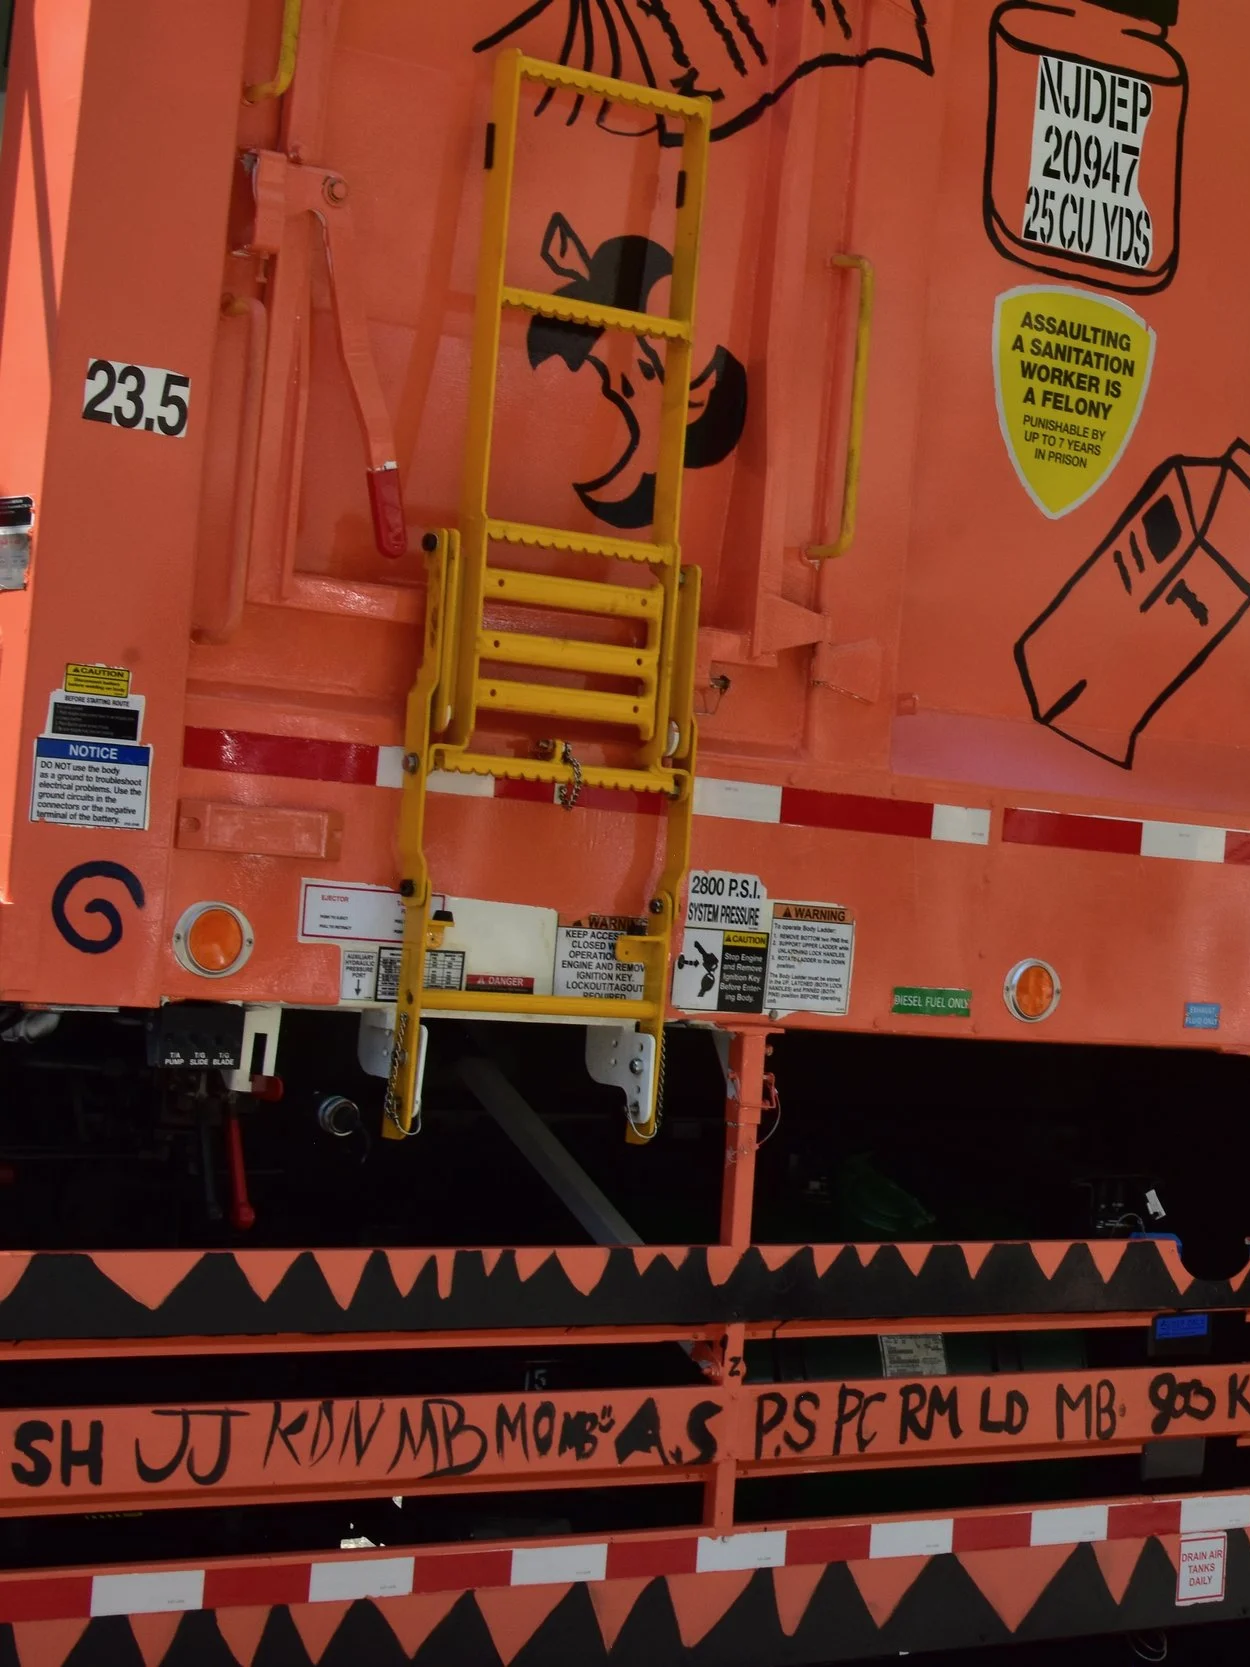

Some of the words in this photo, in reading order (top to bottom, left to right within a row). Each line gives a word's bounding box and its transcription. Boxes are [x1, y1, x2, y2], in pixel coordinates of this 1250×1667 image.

[1039, 57, 1151, 134] NJDEP
[1042, 125, 1139, 196] 20947
[1024, 186, 1055, 243] 25
[1059, 193, 1095, 253] CU
[1102, 202, 1150, 267] YDS
[1021, 312, 1131, 352] ASSAULTING
[1012, 335, 1024, 353] A
[1030, 338, 1135, 377] SANITATION
[1021, 360, 1100, 394] WORKER
[1105, 379, 1121, 398] IS
[82, 360, 190, 436] 23.5
[1023, 387, 1035, 405] A
[1041, 390, 1112, 420] FELONY
[1023, 415, 1089, 438] PUNISHABLE
[1092, 430, 1106, 441] BY
[1024, 431, 1039, 442] UP
[1042, 434, 1056, 446] TO
[1059, 438, 1064, 448] 7
[1068, 439, 1101, 455] YEARS
[1035, 448, 1046, 460] IN
[1048, 451, 1087, 468] PRISON
[80, 667, 124, 677] CAUTION
[69, 744, 118, 759] NOTICE
[55, 762, 71, 770] NOT
[101, 766, 120, 775] body
[57, 773, 84, 782] ground
[95, 775, 141, 786] troubleshoot
[39, 781, 73, 790] electrical
[75, 784, 111, 794] problems.
[114, 786, 128, 795] Use
[130, 788, 141, 796] the
[38, 791, 65, 800] ground
[67, 794, 94, 802] circuits
[37, 801, 79, 811] connectors
[105, 806, 136, 815] negative
[36, 811, 67, 819] terminal
[69, 812, 77, 820] of
[93, 814, 119, 824] battery.
[692, 876, 724, 896] 2800
[729, 879, 760, 899] P.S.I.
[688, 903, 718, 923] SYSTEM
[721, 906, 760, 926] PRESSURE
[795, 908, 845, 921] WARNING
[566, 930, 588, 938] KEEP
[732, 936, 765, 944] CAUTION
[572, 941, 606, 949] CLOSED
[725, 953, 739, 961] Stop
[741, 954, 763, 963] Engine
[562, 961, 593, 969] ENGINE
[596, 962, 613, 970] AND
[616, 963, 644, 972] REMOV
[737, 964, 762, 972] Remove
[488, 976, 523, 986] DANGER
[577, 972, 613, 980] IGNITION
[616, 974, 634, 982] KEY.
[723, 973, 747, 981] Ignition
[748, 975, 760, 983] Key
[720, 983, 741, 991] Before
[725, 994, 735, 1002] ing
[895, 995, 922, 1006] DIESEL
[925, 997, 945, 1007] FUEL
[11, 1420, 104, 1487] SH
[135, 1407, 250, 1485] JJ
[833, 1383, 886, 1456] PC
[899, 1383, 963, 1444] RM
[980, 1386, 1028, 1435] LD
[1182, 1552, 1207, 1562] DRAIN
[1209, 1550, 1222, 1559] AIR
[1188, 1563, 1215, 1574] TANKS
[1190, 1576, 1212, 1586] DAILY
